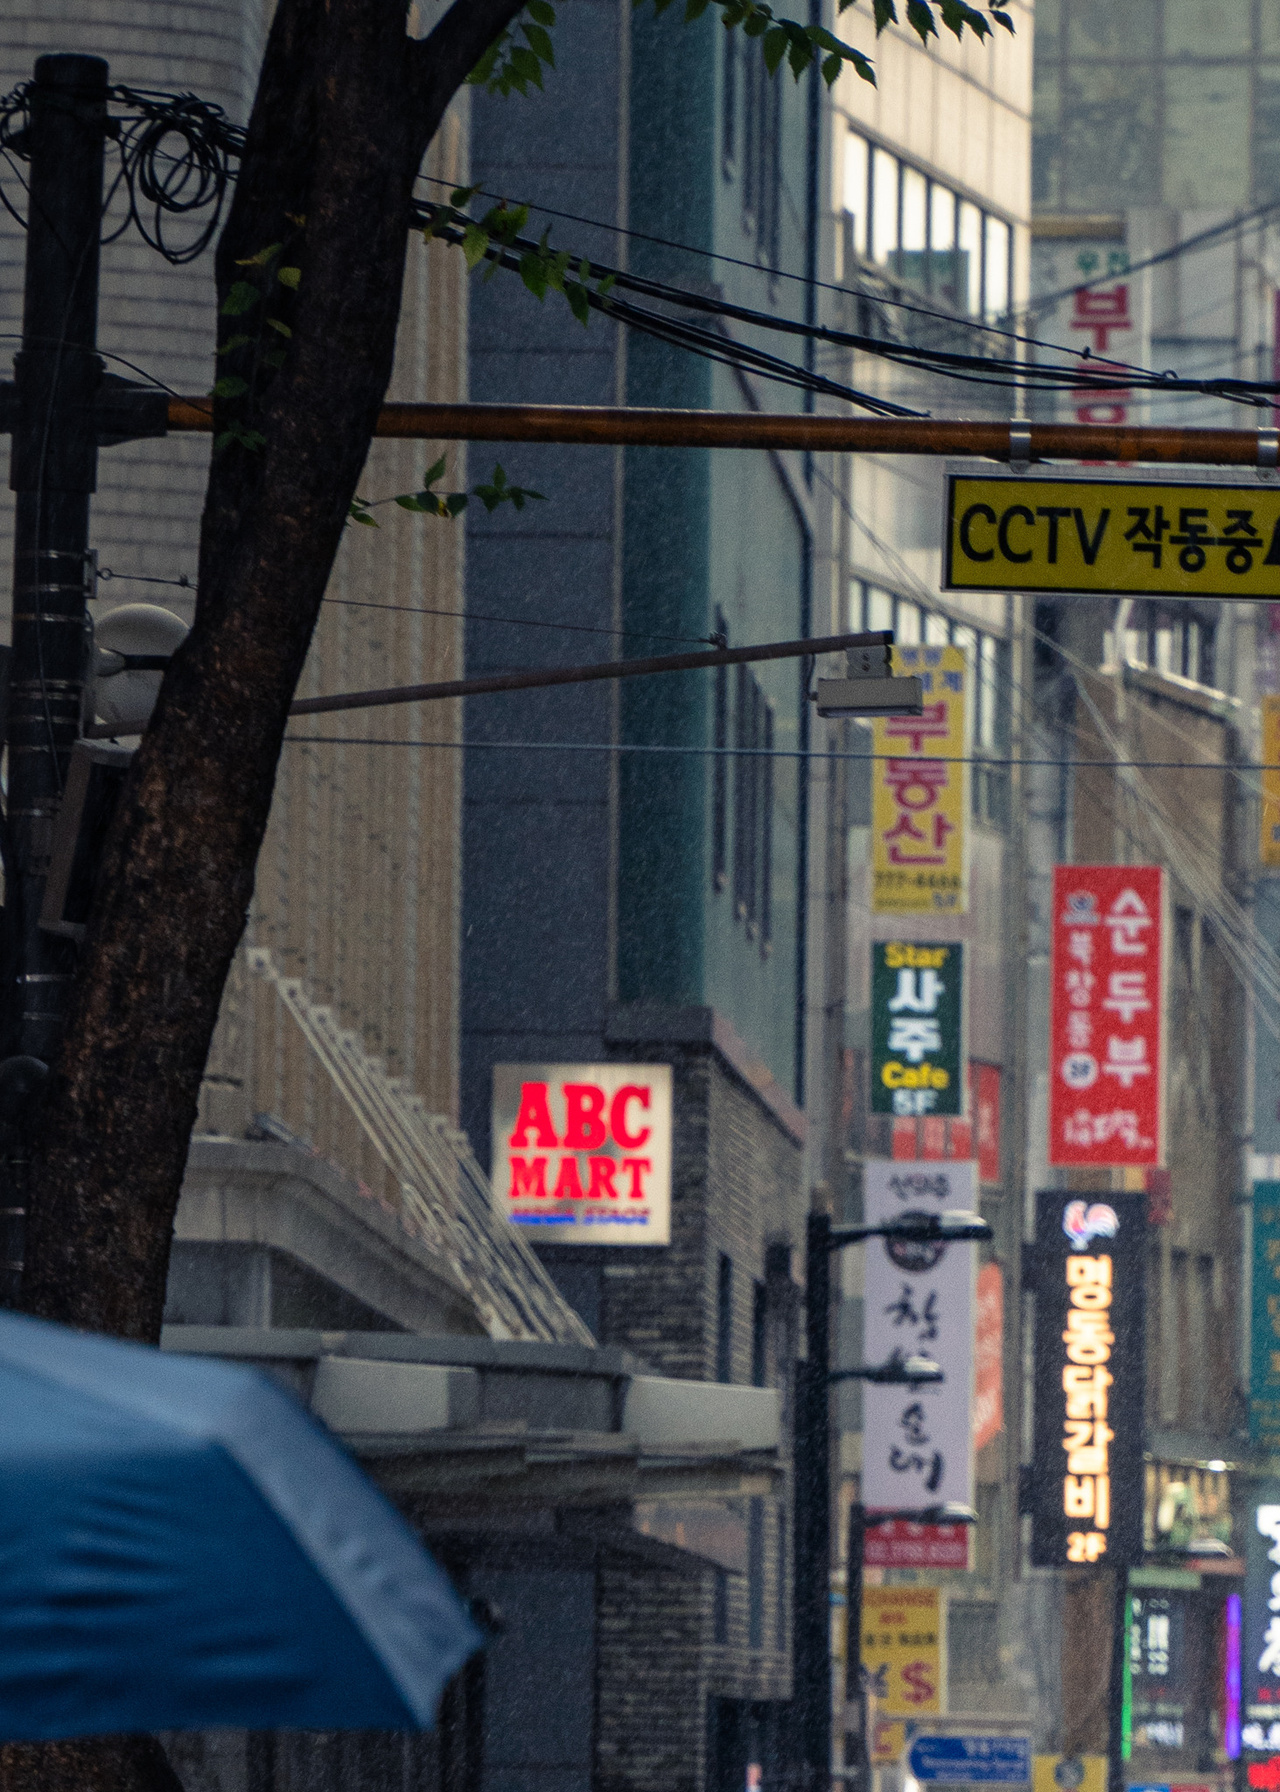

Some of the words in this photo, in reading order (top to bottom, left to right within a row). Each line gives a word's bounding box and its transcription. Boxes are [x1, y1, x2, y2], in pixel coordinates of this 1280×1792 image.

[959, 504, 1110, 565] CCTV
[1123, 506, 1264, 574] 작동중
[883, 701, 954, 865] 부동산
[884, 943, 949, 968] Star
[1102, 888, 1152, 1088] 순두부
[887, 967, 946, 1063] 사주
[881, 1061, 950, 1089] Cafe
[507, 1081, 652, 1150] ABC
[507, 1155, 652, 1200] MART
